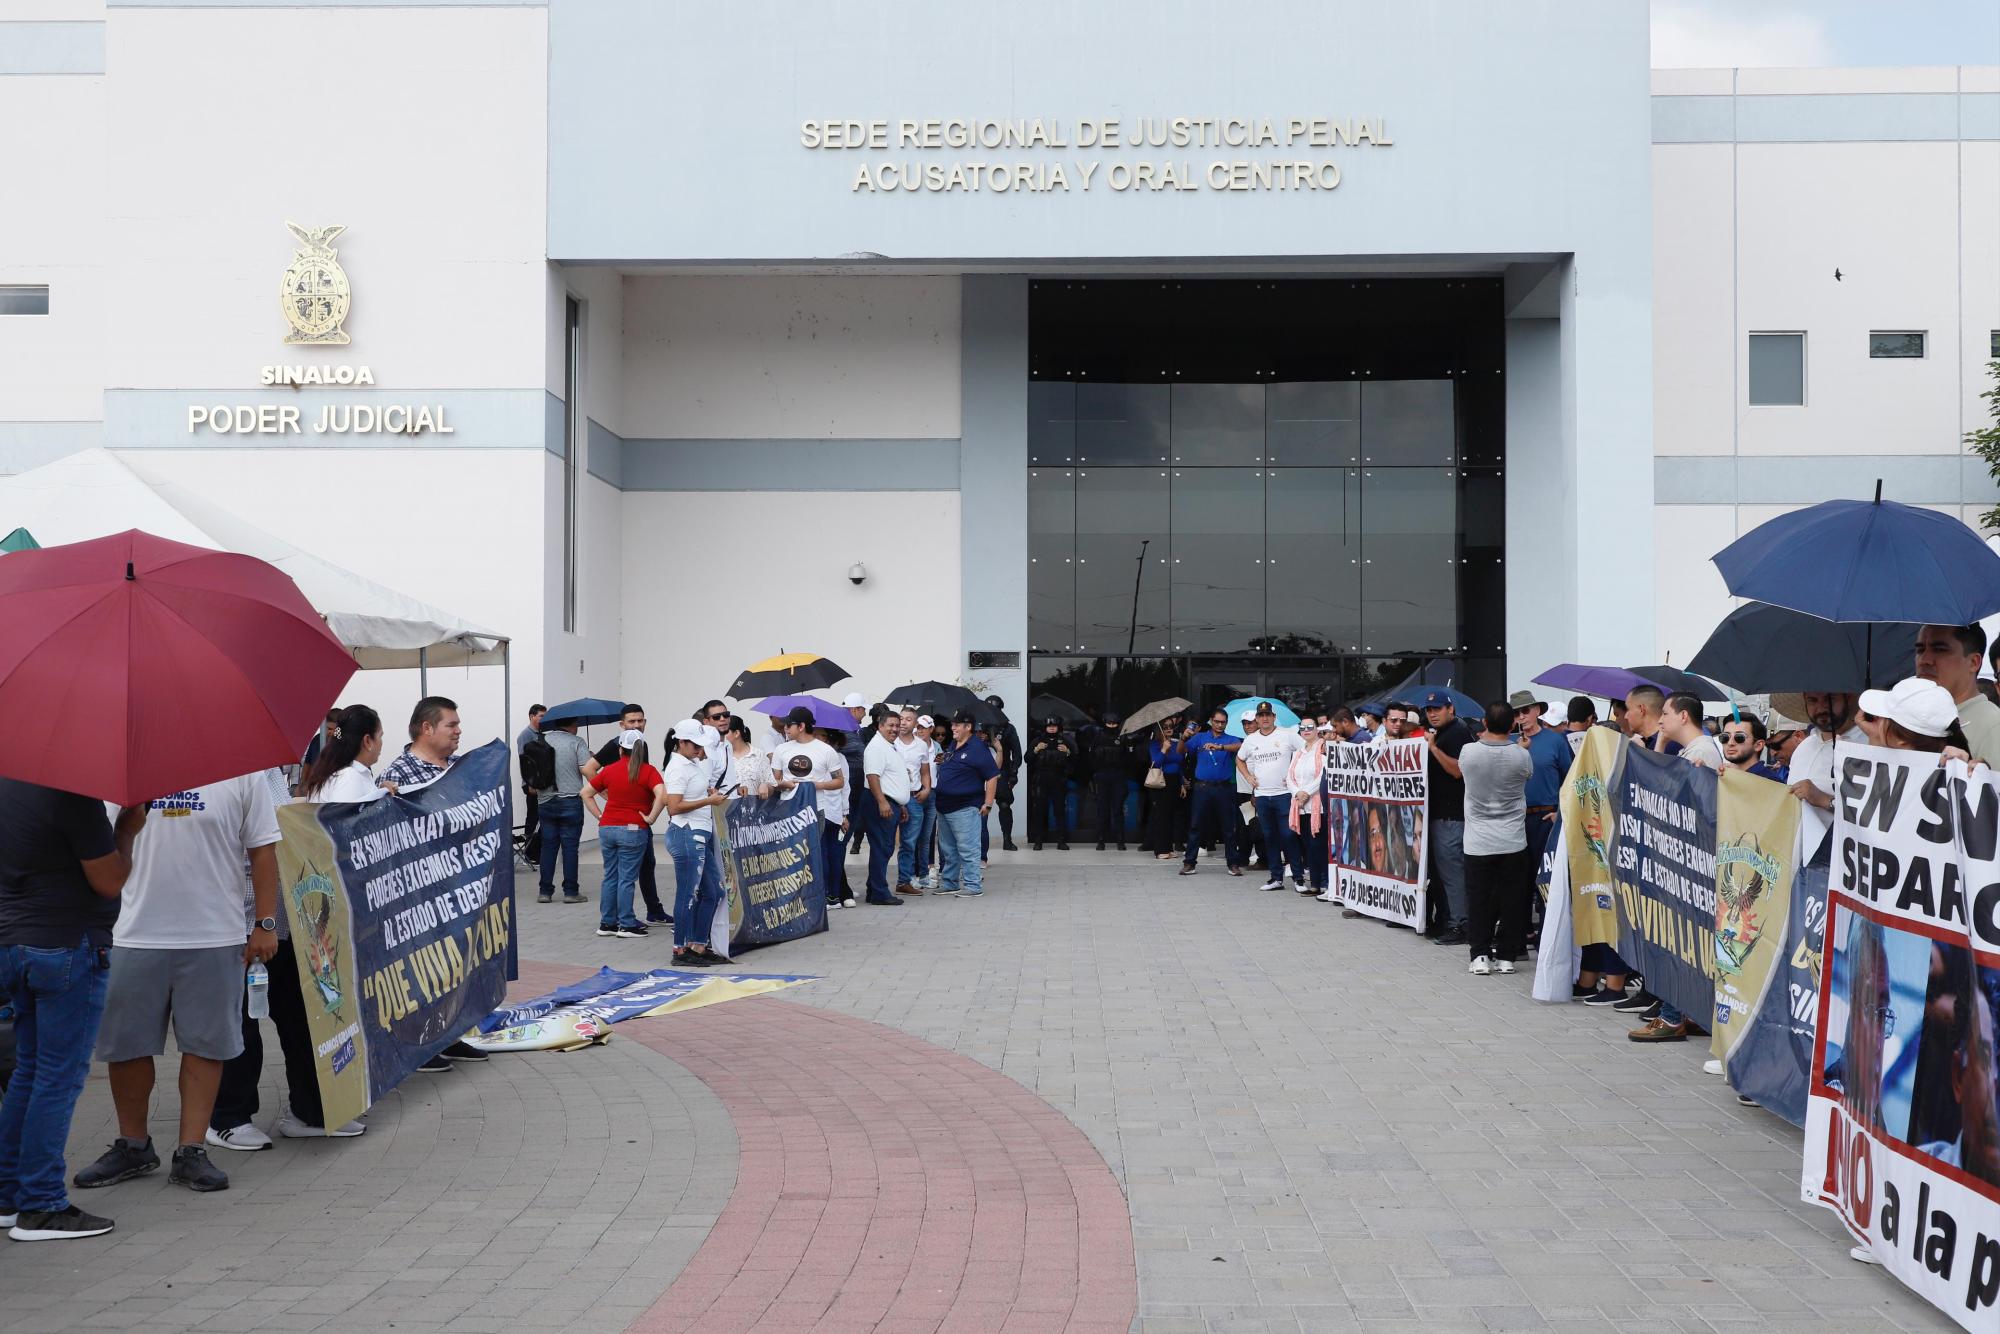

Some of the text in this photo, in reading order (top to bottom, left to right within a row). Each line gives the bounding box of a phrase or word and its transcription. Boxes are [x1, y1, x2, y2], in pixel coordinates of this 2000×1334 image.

[801, 117, 1394, 149] SEDE REGIONAL DE JUSTICIA PENAL
[853, 160, 1341, 192] ACUSATORIA Y ORAL CENTRO
[261, 365, 375, 386] SINALOA
[188, 404, 454, 433] PODER JUDICIAL
[1394, 744, 1421, 771] HAY
[151, 800, 205, 811] GRANDES
[1840, 757, 1910, 833] EN
[1669, 800, 1680, 828] NO
[1681, 805, 1696, 835] HAY
[350, 837, 368, 870] EN
[414, 811, 444, 844] HAY
[1652, 827, 1684, 865] PODERES
[778, 848, 801, 869] QUE
[366, 868, 405, 912] PODERES
[402, 847, 462, 893] EXIGIMOS
[1348, 875, 1356, 900] la
[1642, 857, 1653, 883] AL
[1654, 862, 1680, 898] ESTADO
[1681, 876, 1692, 904] DE
[384, 919, 398, 950] AL
[395, 901, 438, 943] ESTADO
[435, 892, 458, 924] DE
[1641, 894, 1677, 956] VIVA
[1678, 913, 1697, 969] LA
[409, 935, 464, 1004] VIVA
[318, 1034, 340, 1058] SOMOS
[1823, 1107, 1873, 1229] NO
[1881, 1180, 1900, 1248] a
[1913, 1181, 1957, 1281] la
